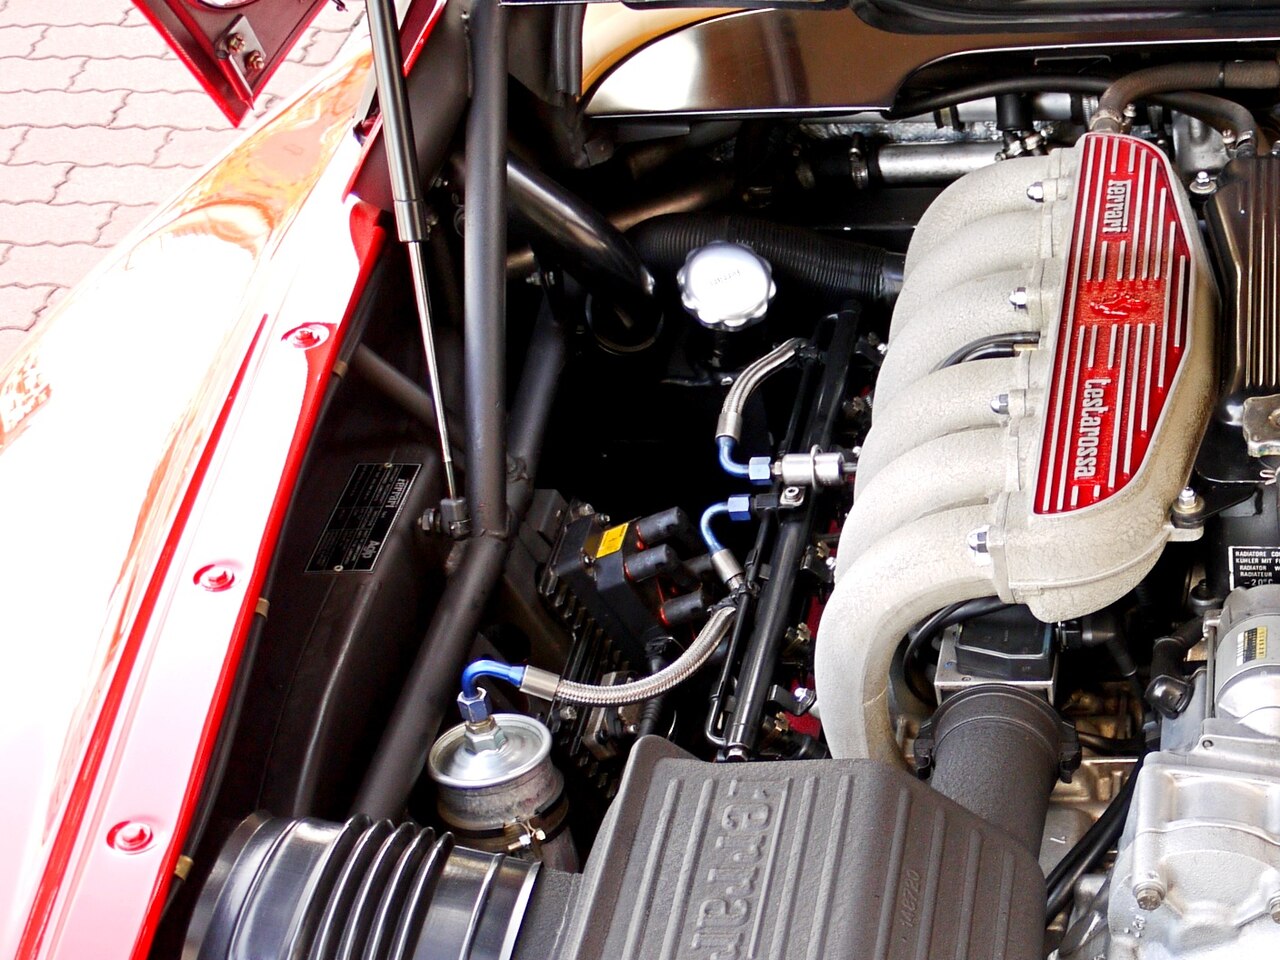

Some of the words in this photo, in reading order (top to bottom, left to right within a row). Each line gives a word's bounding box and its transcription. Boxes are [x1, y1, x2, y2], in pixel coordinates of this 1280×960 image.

[1102, 180, 1131, 233] Ferrari
[1074, 379, 1111, 480] testarossa
[385, 478, 410, 510] Ferrari
